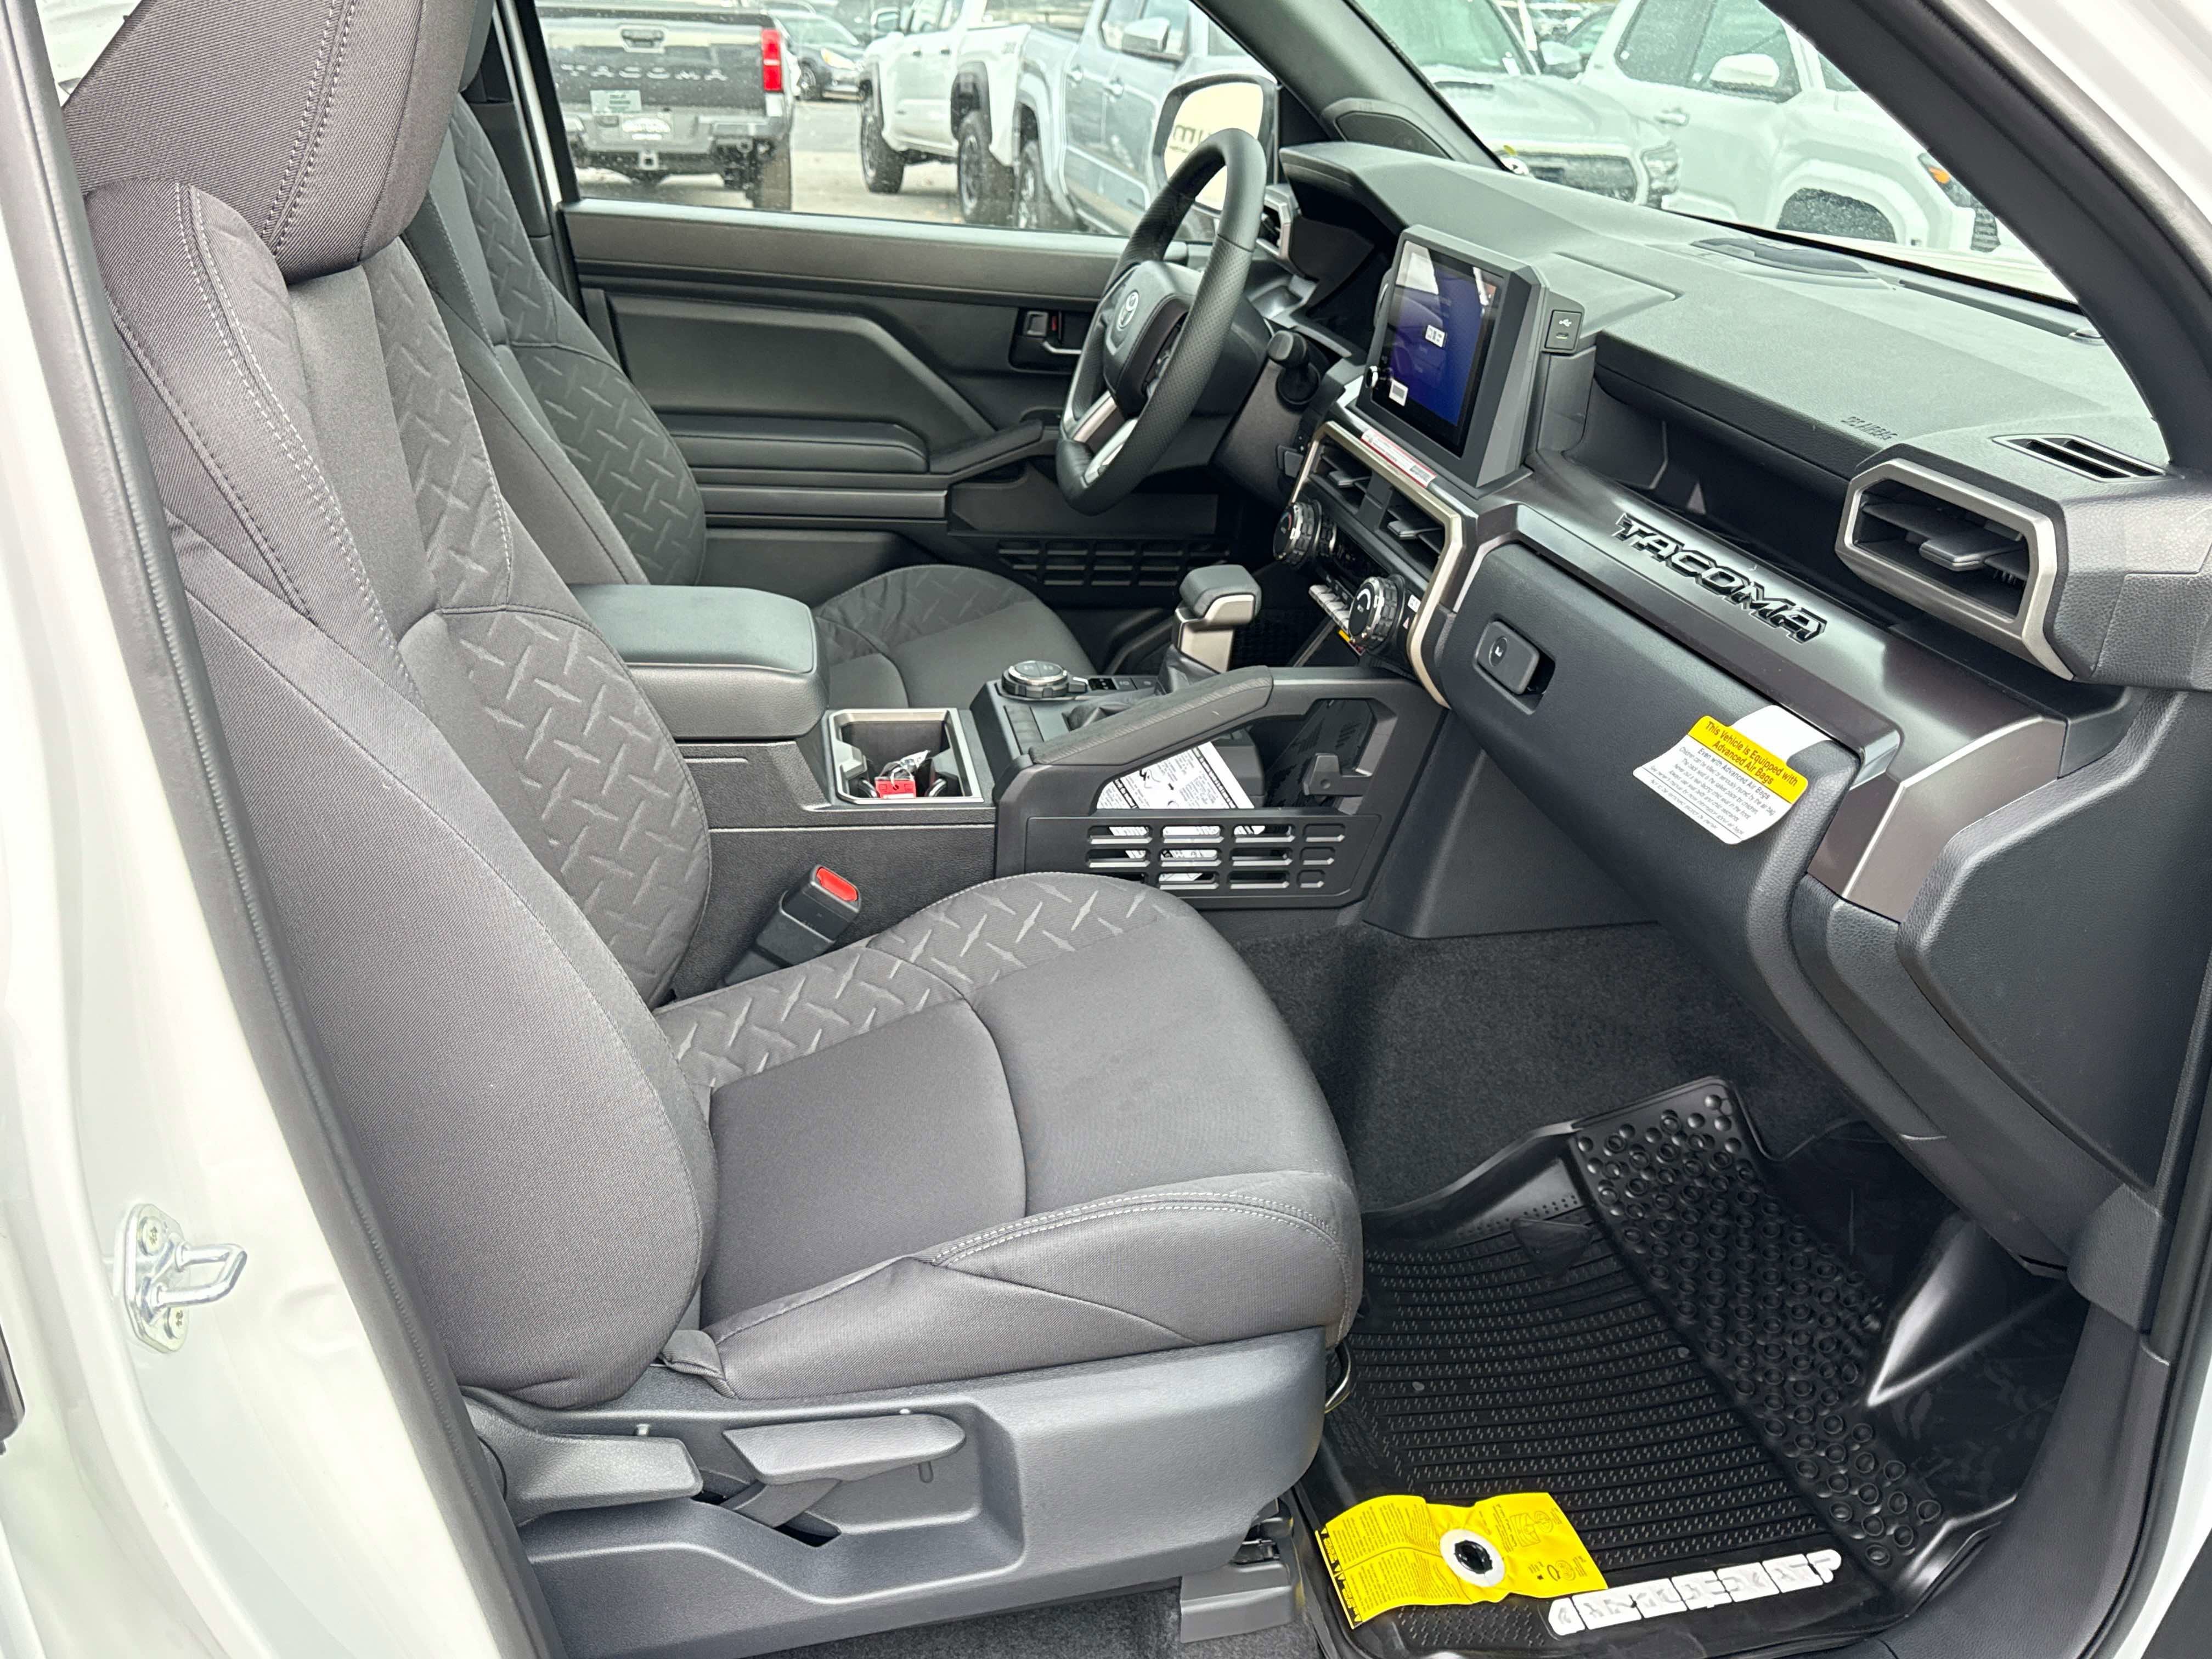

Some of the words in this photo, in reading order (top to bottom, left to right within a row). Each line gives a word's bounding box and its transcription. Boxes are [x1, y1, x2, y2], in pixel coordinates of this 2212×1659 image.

[560, 64, 728, 81] TACOMA
[1612, 512, 1827, 645] TACOMA
[1697, 748, 1711, 759] Even
[1711, 758, 1722, 766] with
[1722, 765, 1748, 784] Advanced
[1755, 787, 1770, 799] Bags
[1706, 721, 1719, 736] This
[1720, 730, 1743, 751] Vehicle
[1743, 747, 1751, 755] is
[1748, 749, 1784, 776] Equipped
[1781, 771, 1798, 786] with
[1713, 740, 1746, 766] Advanced
[1744, 761, 1757, 773] Air
[1755, 768, 1773, 784] Bags
